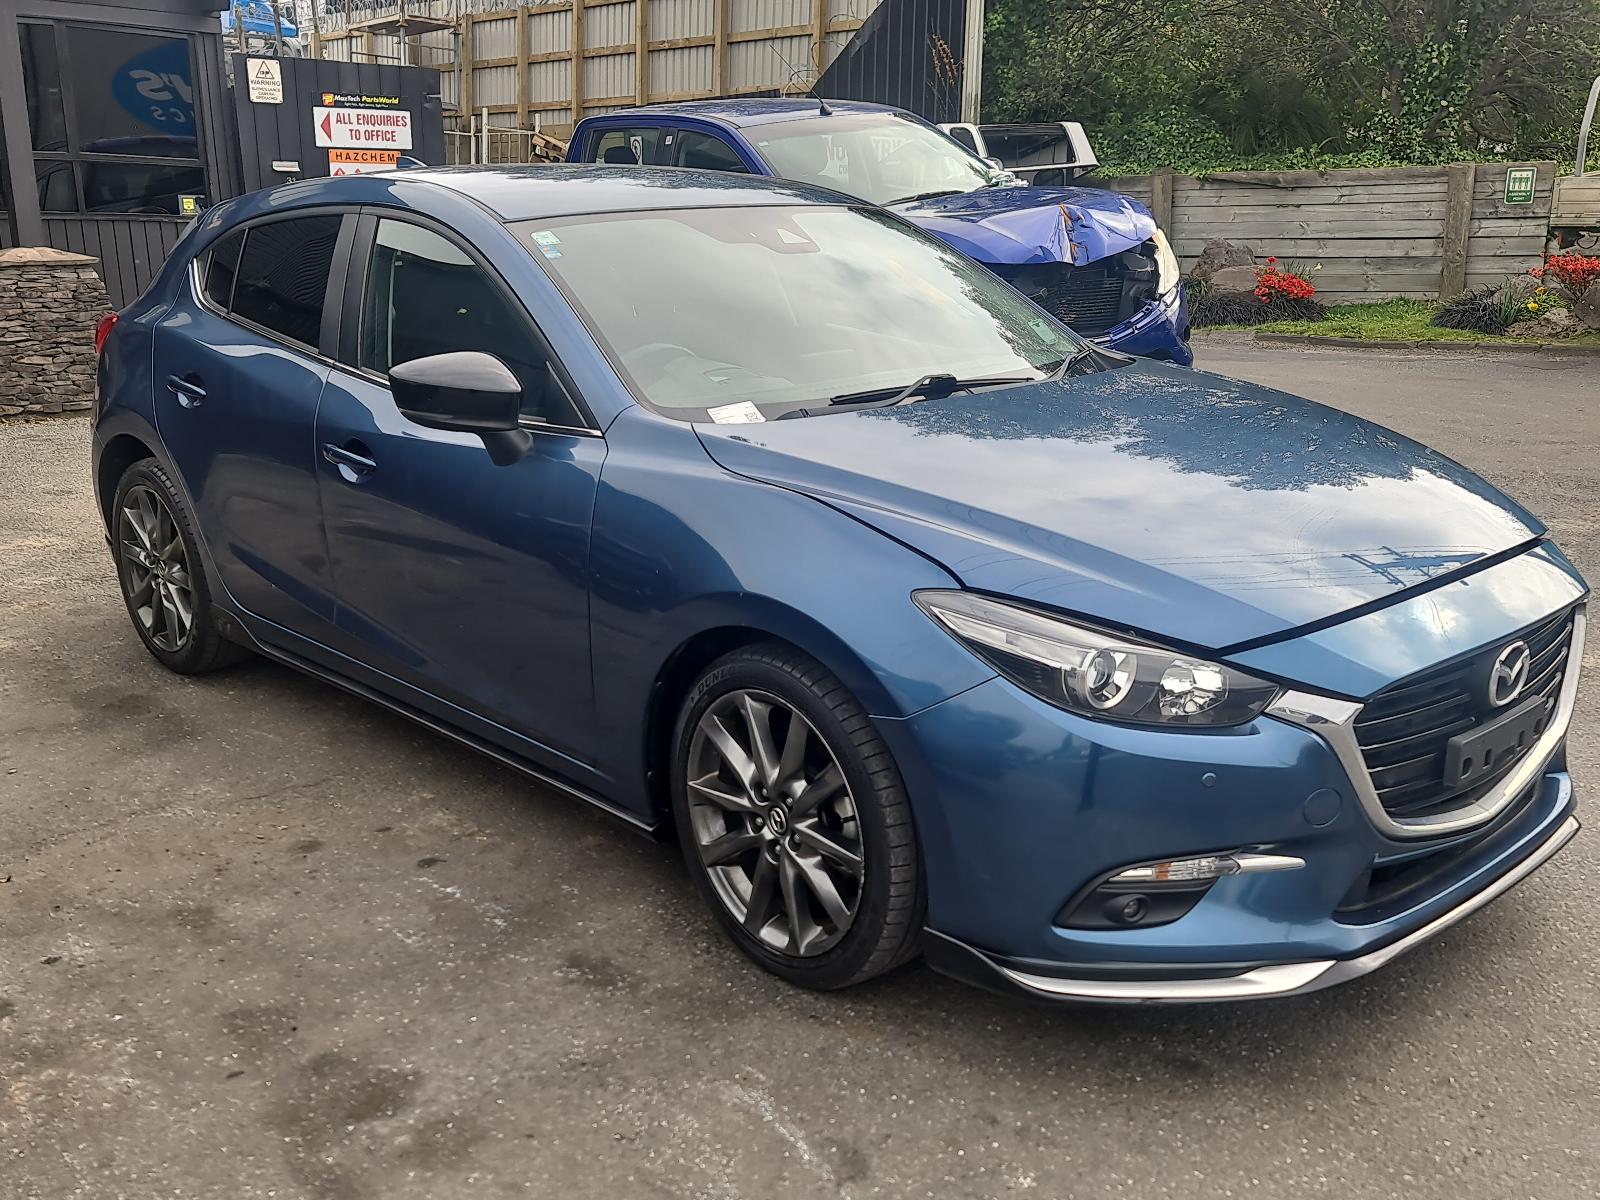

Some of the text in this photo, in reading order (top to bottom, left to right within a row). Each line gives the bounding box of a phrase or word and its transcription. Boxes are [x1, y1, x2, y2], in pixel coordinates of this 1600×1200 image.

[250, 79, 281, 87] WARNING
[361, 96, 399, 104] PartsWorld
[335, 112, 408, 128] ALL ENQUIRIES
[348, 128, 397, 143] TO OFFICE
[335, 151, 396, 162] HAZCHEM
